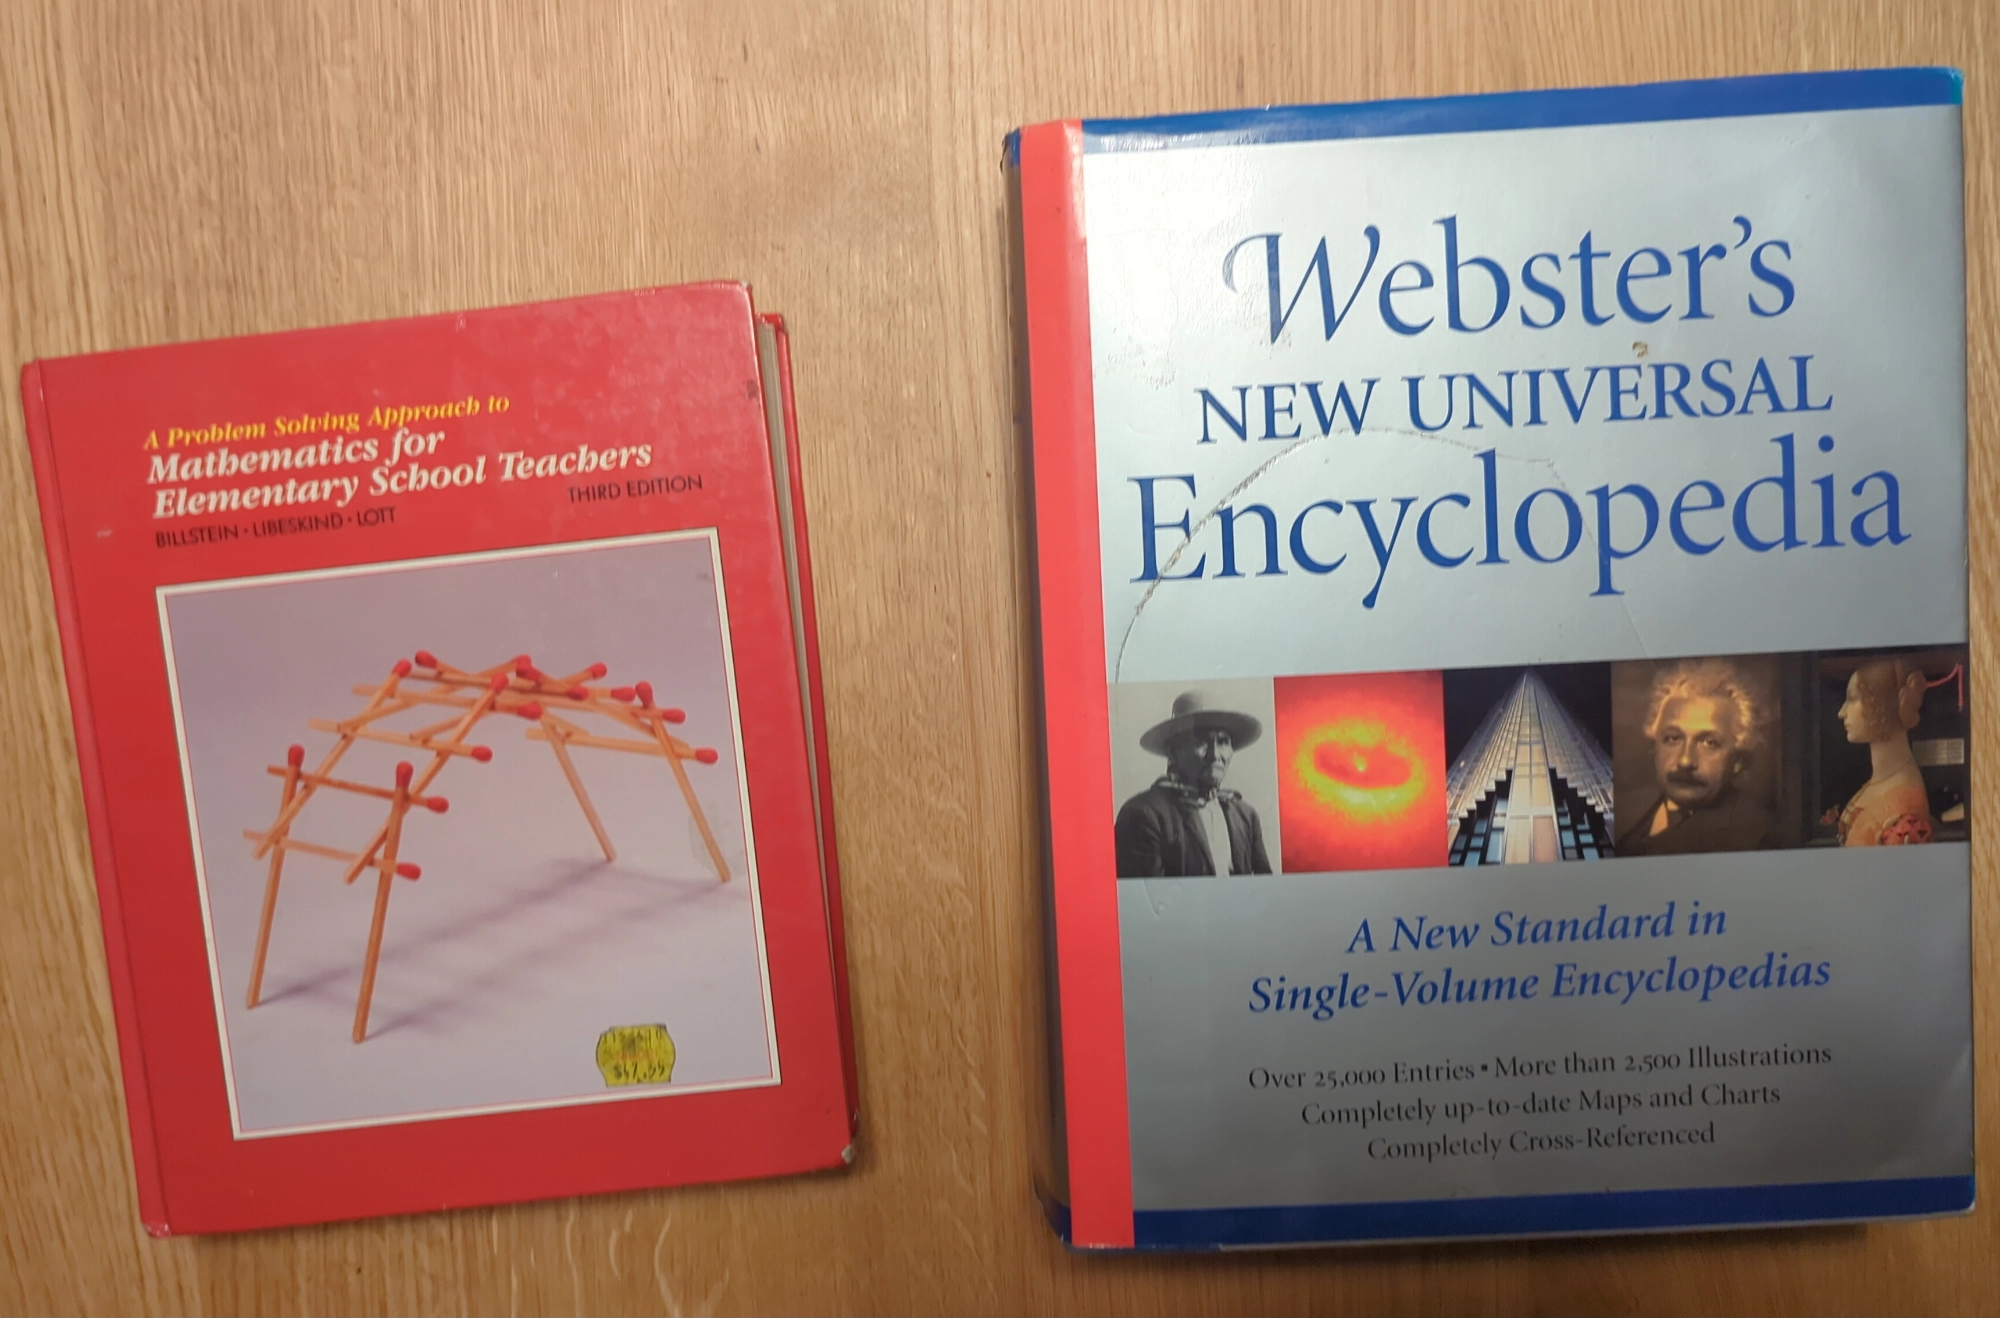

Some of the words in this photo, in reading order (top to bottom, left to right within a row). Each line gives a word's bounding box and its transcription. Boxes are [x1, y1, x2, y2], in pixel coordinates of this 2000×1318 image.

[1222, 214, 1794, 345] Webster's
[145, 430, 159, 449] A
[167, 421, 266, 448] Problem
[275, 411, 360, 434] Solving
[368, 396, 480, 430] Approach
[487, 394, 510, 414] to
[1195, 378, 1380, 445] NEW
[1407, 355, 1833, 432] UNIVERSAL
[148, 436, 378, 484] Mathematics
[385, 428, 445, 467] for
[154, 475, 360, 518] Elementary
[371, 456, 486, 496] School
[499, 442, 653, 482] Teachers
[569, 483, 622, 503] THIRD
[627, 474, 703, 498] EDITION
[155, 523, 239, 548] BILLSTEIN
[253, 512, 343, 538] LIBESKIND
[357, 507, 396, 528] LOTT
[1127, 433, 1911, 609] Encyclopedia
[1346, 918, 1376, 954] A
[1389, 916, 1480, 952] New
[1490, 902, 1675, 947] Standard
[1687, 900, 1727, 936] in
[1249, 968, 1539, 1021] Single-Volume
[1551, 952, 1831, 1004] Encyclopedias
[1248, 1067, 1305, 1089] Over
[1314, 1066, 1386, 1090] 25,000
[1394, 1059, 1475, 1083] Entries
[1495, 1056, 1556, 1078] More
[1563, 1051, 1617, 1075] than
[1624, 1051, 1681, 1074] 2,500
[1688, 1043, 1832, 1069] Illustrations
[1301, 1096, 1436, 1129] Completely
[1444, 1091, 1572, 1122] up-to-date
[1578, 1088, 1642, 1114] Maps
[1648, 1084, 1693, 1107] and
[1701, 1082, 1781, 1105] Charts
[1367, 1133, 1501, 1164] Completely
[1509, 1122, 1715, 1153] Cross-Referenced
